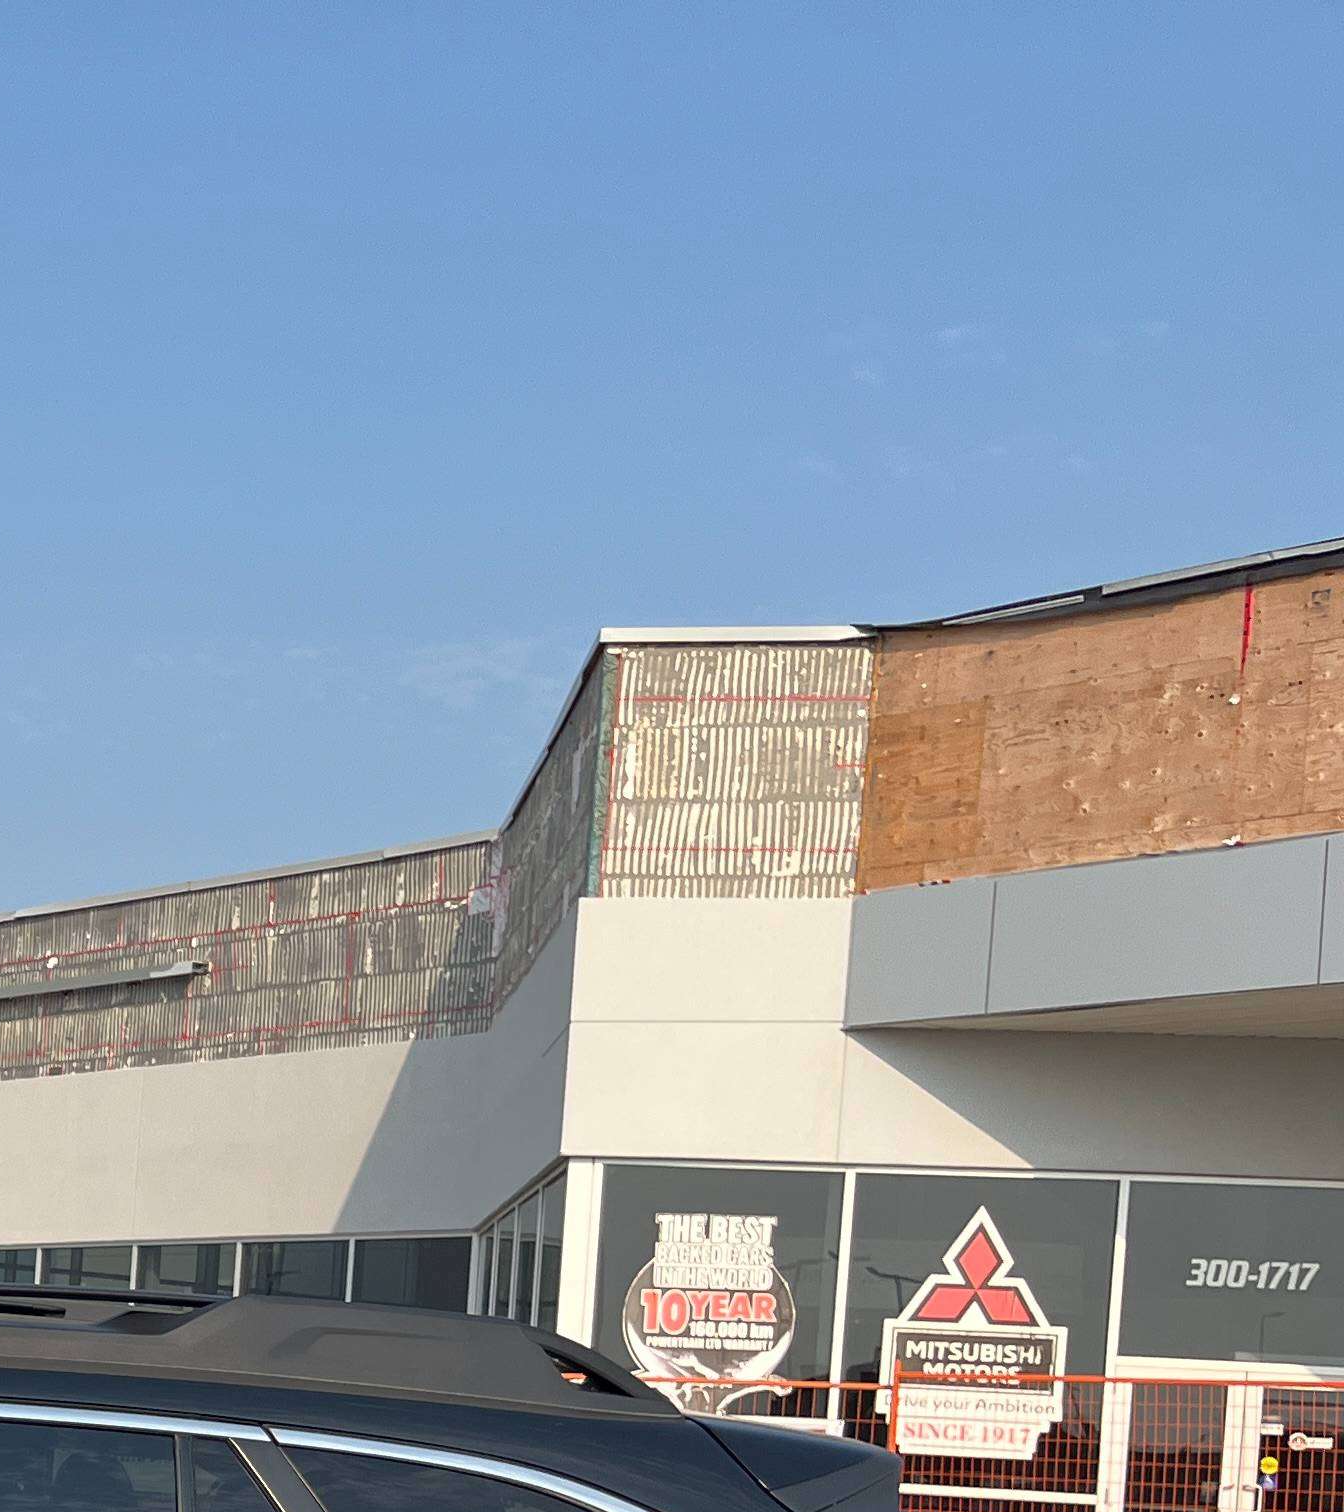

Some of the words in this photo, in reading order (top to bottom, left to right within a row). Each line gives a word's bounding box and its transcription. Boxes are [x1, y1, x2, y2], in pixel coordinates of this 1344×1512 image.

[655, 1213, 707, 1244] THE
[709, 1214, 778, 1246] BEST
[655, 1243, 723, 1265] BACKED
[725, 1245, 774, 1266] CARS
[708, 1266, 774, 1290] WORLD
[1185, 1257, 1320, 1290] 300-1717
[641, 1288, 690, 1335] 10
[686, 1290, 777, 1322] YEAR
[905, 1339, 1042, 1365] MITSUBISHI
[884, 1393, 928, 1408] Dive
[932, 1398, 970, 1411] your
[975, 1398, 1056, 1415] Ambition
[903, 1421, 972, 1441] SINCE
[982, 1425, 1031, 1445] 1917
